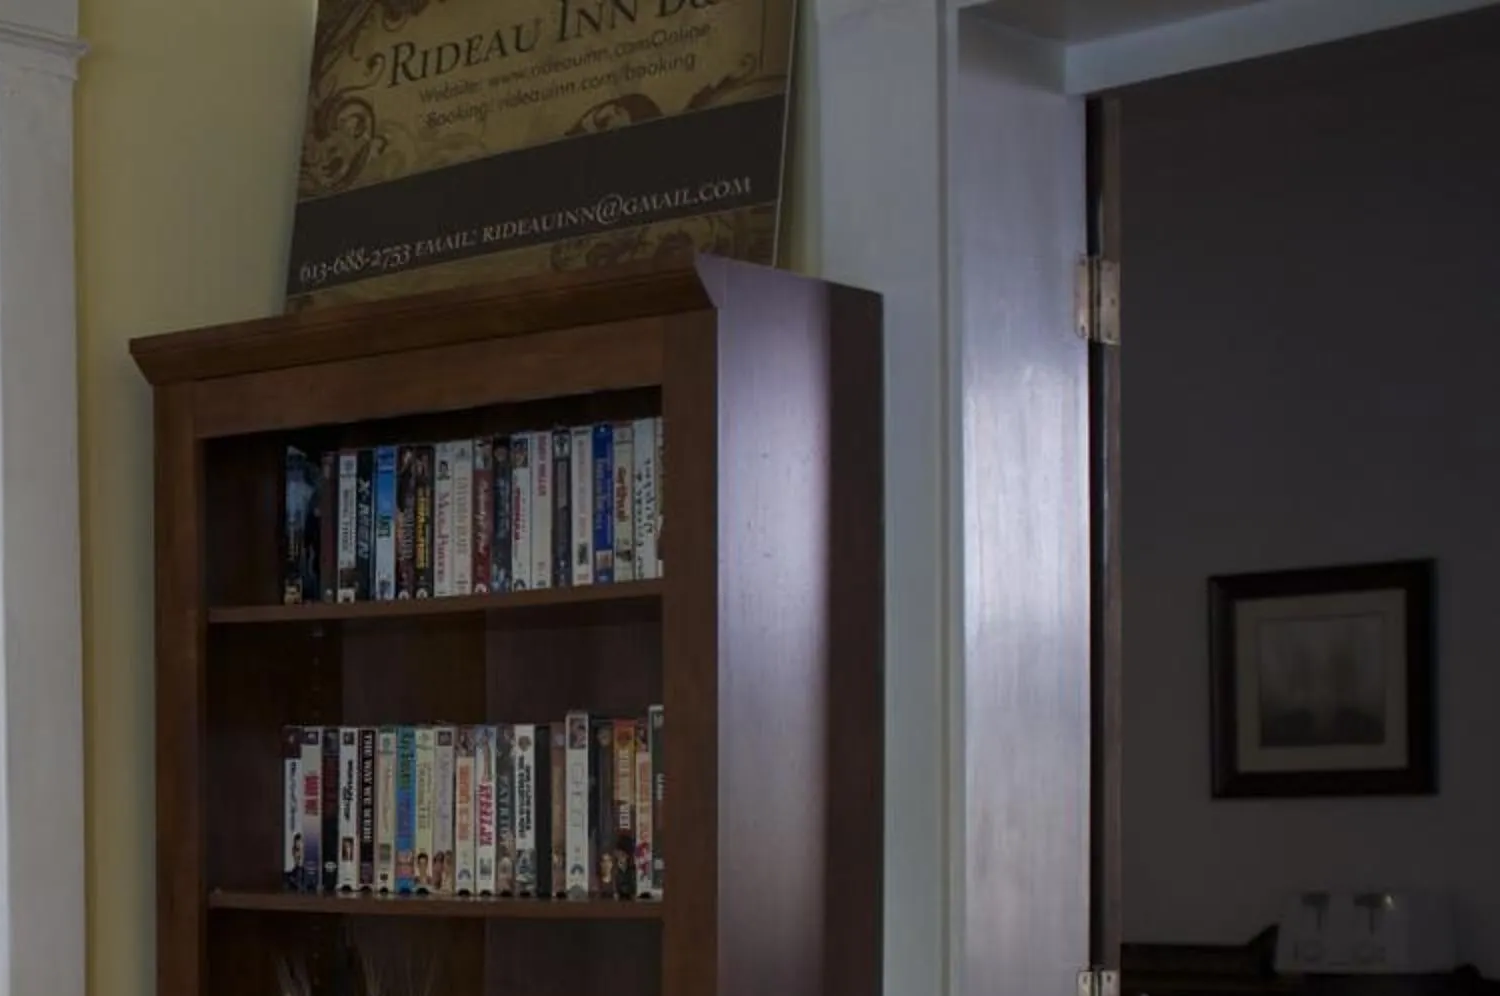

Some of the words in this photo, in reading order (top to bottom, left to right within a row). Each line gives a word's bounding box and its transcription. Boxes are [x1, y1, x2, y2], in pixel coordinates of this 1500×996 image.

[387, 16, 543, 89] RIDEAU
[299, 243, 412, 283] 613-688-2753
[482, 175, 752, 242] RIDEAUINN@GMAIL.COM
